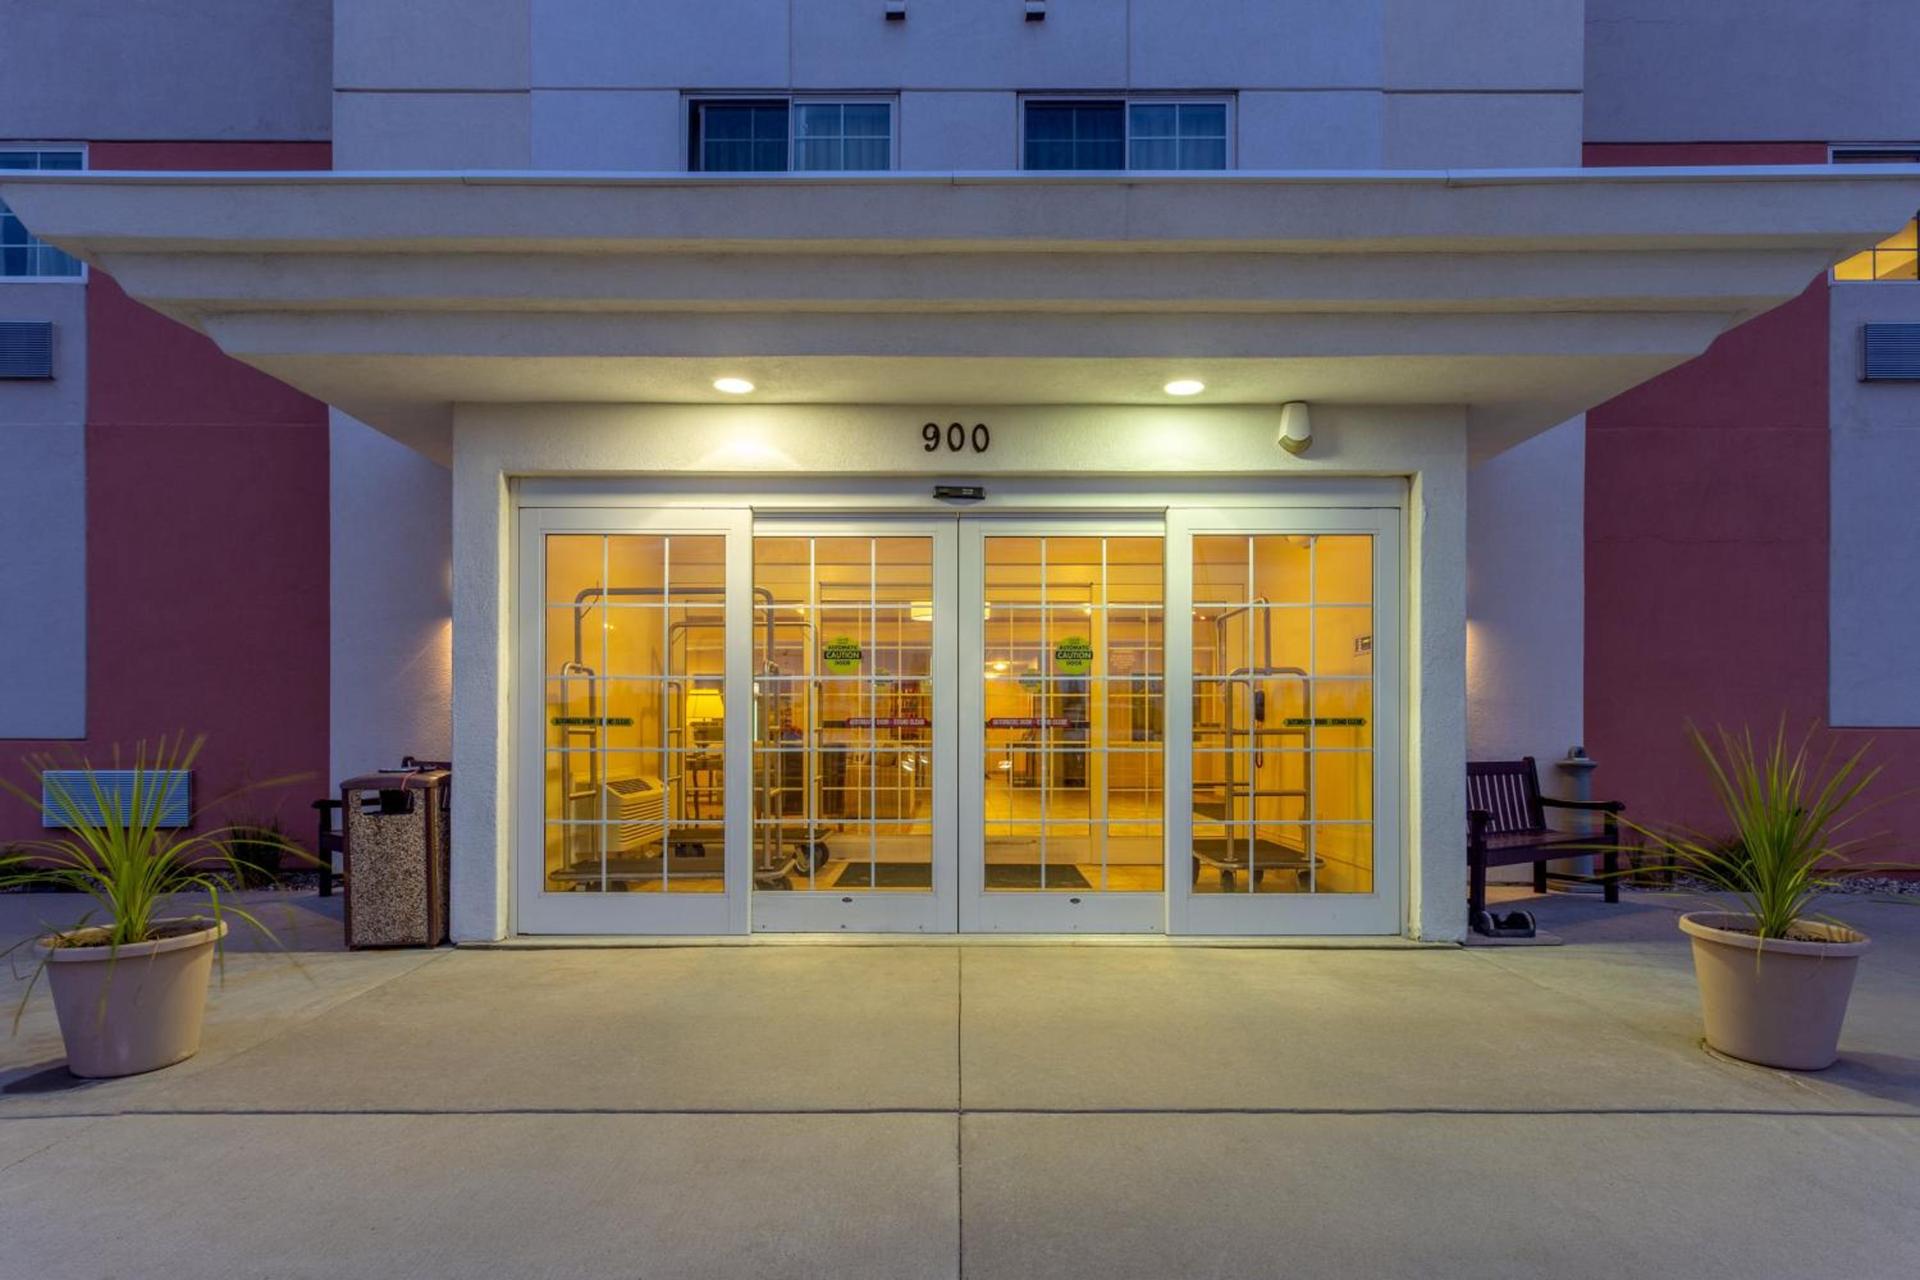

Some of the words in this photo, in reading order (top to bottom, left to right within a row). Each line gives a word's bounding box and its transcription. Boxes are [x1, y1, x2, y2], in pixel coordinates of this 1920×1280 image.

[922, 422, 990, 453] 900
[826, 651, 860, 659] CAUTION
[1057, 651, 1091, 659] CAUTION
